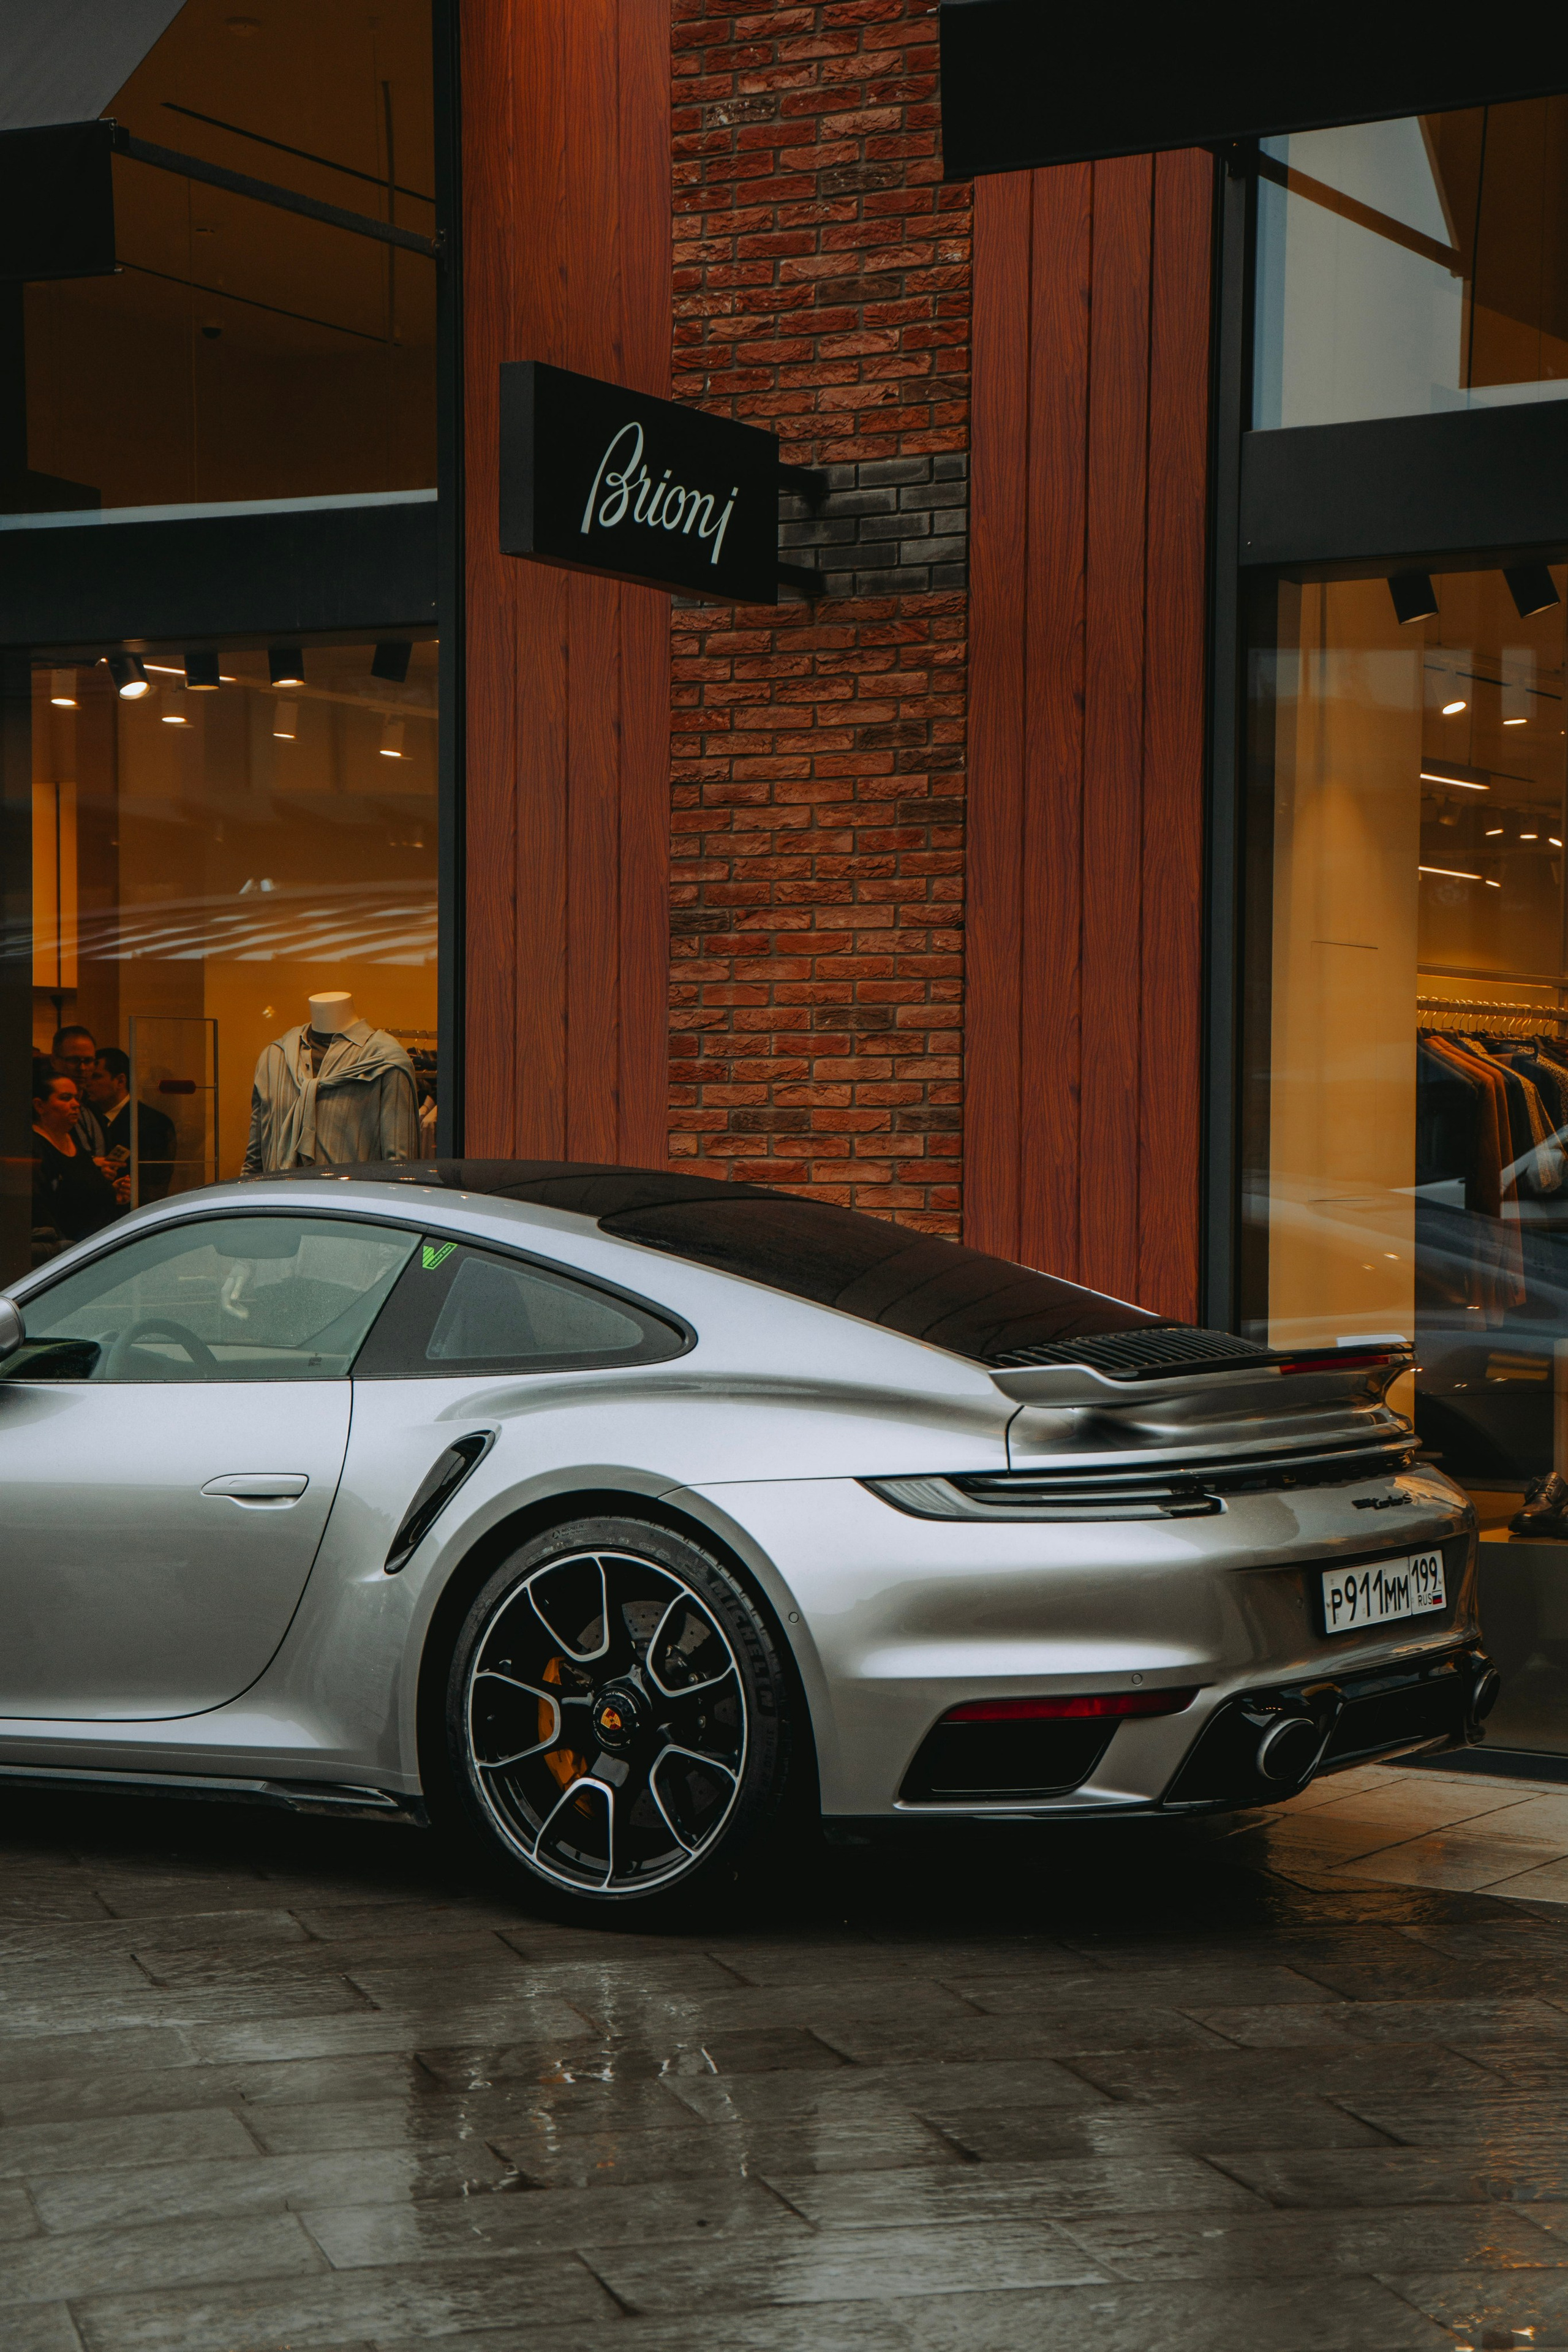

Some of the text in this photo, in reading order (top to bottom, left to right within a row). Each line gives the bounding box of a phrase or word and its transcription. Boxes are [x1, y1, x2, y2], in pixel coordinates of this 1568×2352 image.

[580, 421, 738, 565] Brioni
[429, 1245, 452, 1267] TRACK DAY
[1402, 1493, 1413, 1505] S
[1330, 1556, 1438, 1624] P911MM 199
[1417, 1593, 1433, 1607] RUS
[709, 1579, 775, 1708] MICHELIN
